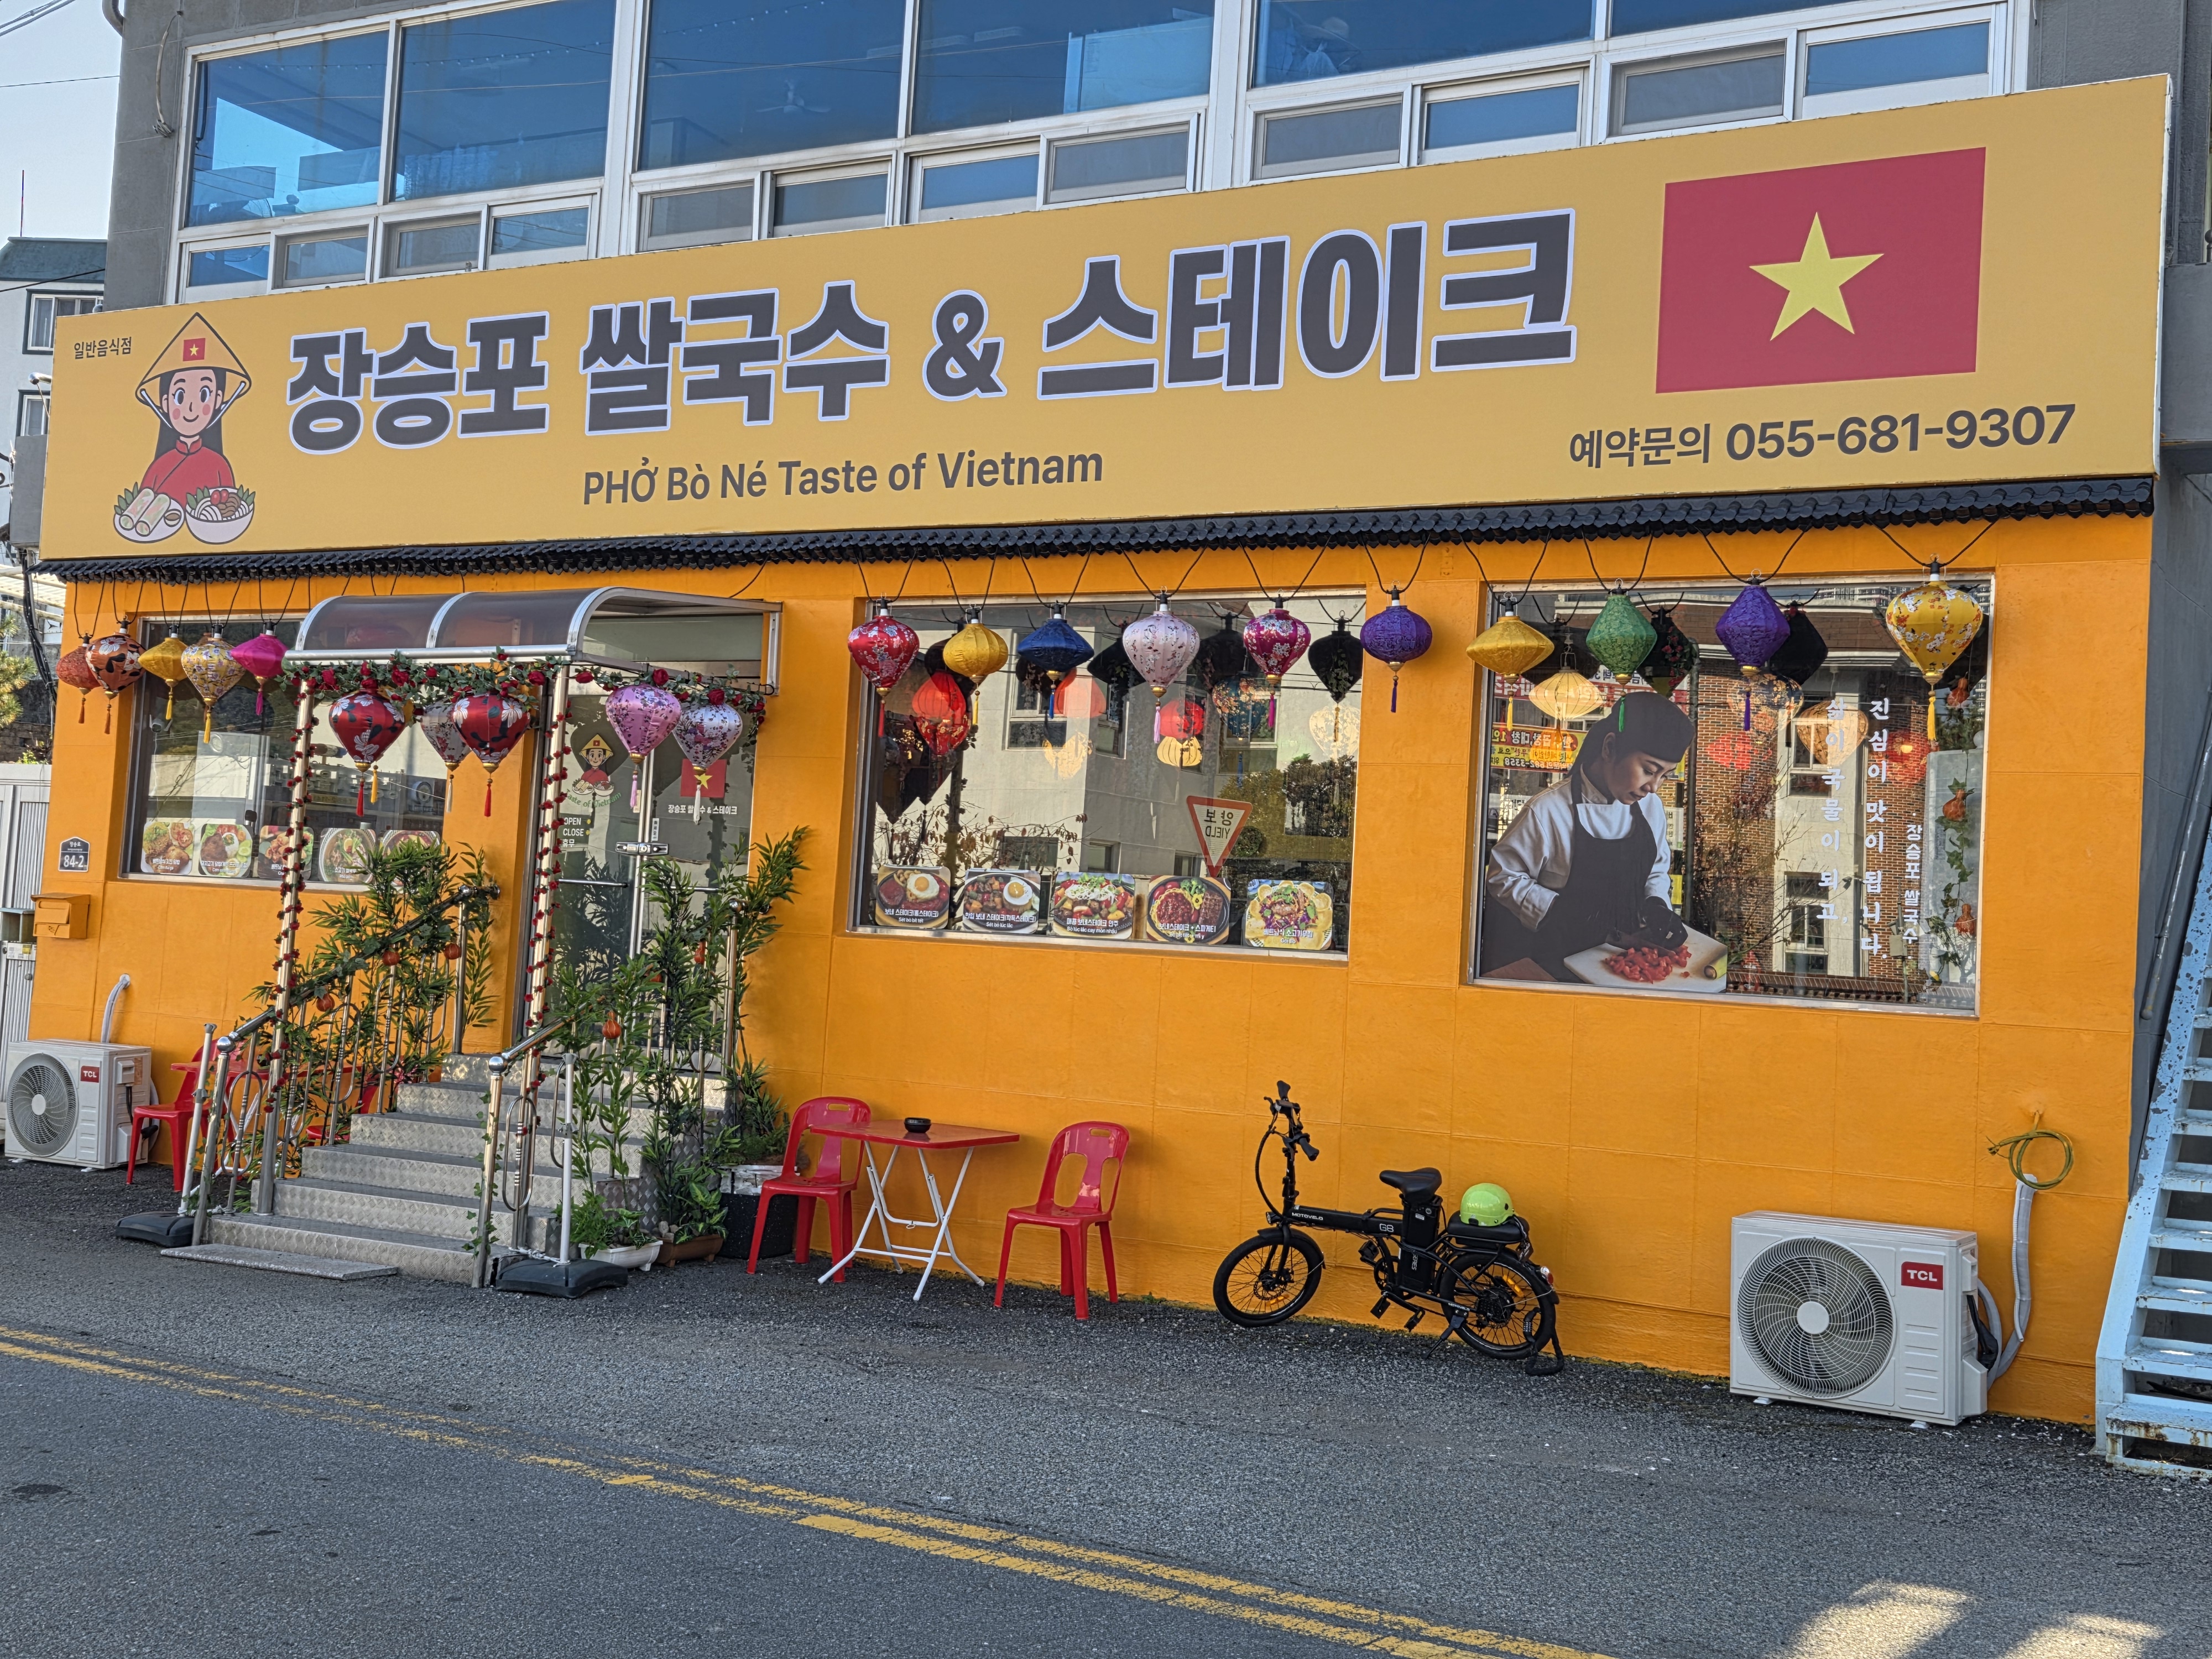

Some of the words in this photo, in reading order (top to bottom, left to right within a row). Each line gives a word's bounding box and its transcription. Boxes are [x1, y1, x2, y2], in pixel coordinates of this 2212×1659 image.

[74, 336, 132, 359] 일반음식점
[287, 311, 549, 455] 장승포
[580, 280, 889, 436] 쌀국수
[922, 289, 1008, 401] &
[1037, 208, 1577, 400] 스테이크
[1569, 423, 1710, 469] 예약문의
[1726, 404, 2076, 461] 055-681-9307
[583, 457, 659, 505] PHỞ
[667, 463, 710, 501] Bò
[721, 460, 767, 498] Né
[778, 460, 877, 495] Taste
[888, 452, 927, 491] of
[937, 450, 1103, 488] Vietnam
[1868, 697, 1889, 783] 진심이
[566, 789, 581, 805] Taste
[583, 800, 591, 808] of
[594, 792, 622, 808] Vietnam
[668, 805, 686, 813] 장승포
[687, 805, 706, 814] 쌀수
[713, 806, 737, 815] 스테이크
[1820, 769, 1846, 852] 국물이
[562, 838, 575, 847] 휴무
[1865, 799, 1888, 853] 맛이
[1905, 824, 1922, 879] 장승포
[64, 854, 84, 868] 84-2
[1816, 868, 1848, 924] 되고,
[1861, 870, 1887, 958] 됩니다.
[1902, 890, 1920, 945] 쌀국수
[1264, 928, 1285, 936] 베트남식
[1292, 1212, 1323, 1220] MOTOVELO
[1379, 1223, 1394, 1232] G8
[1907, 1269, 1938, 1282] TCL
